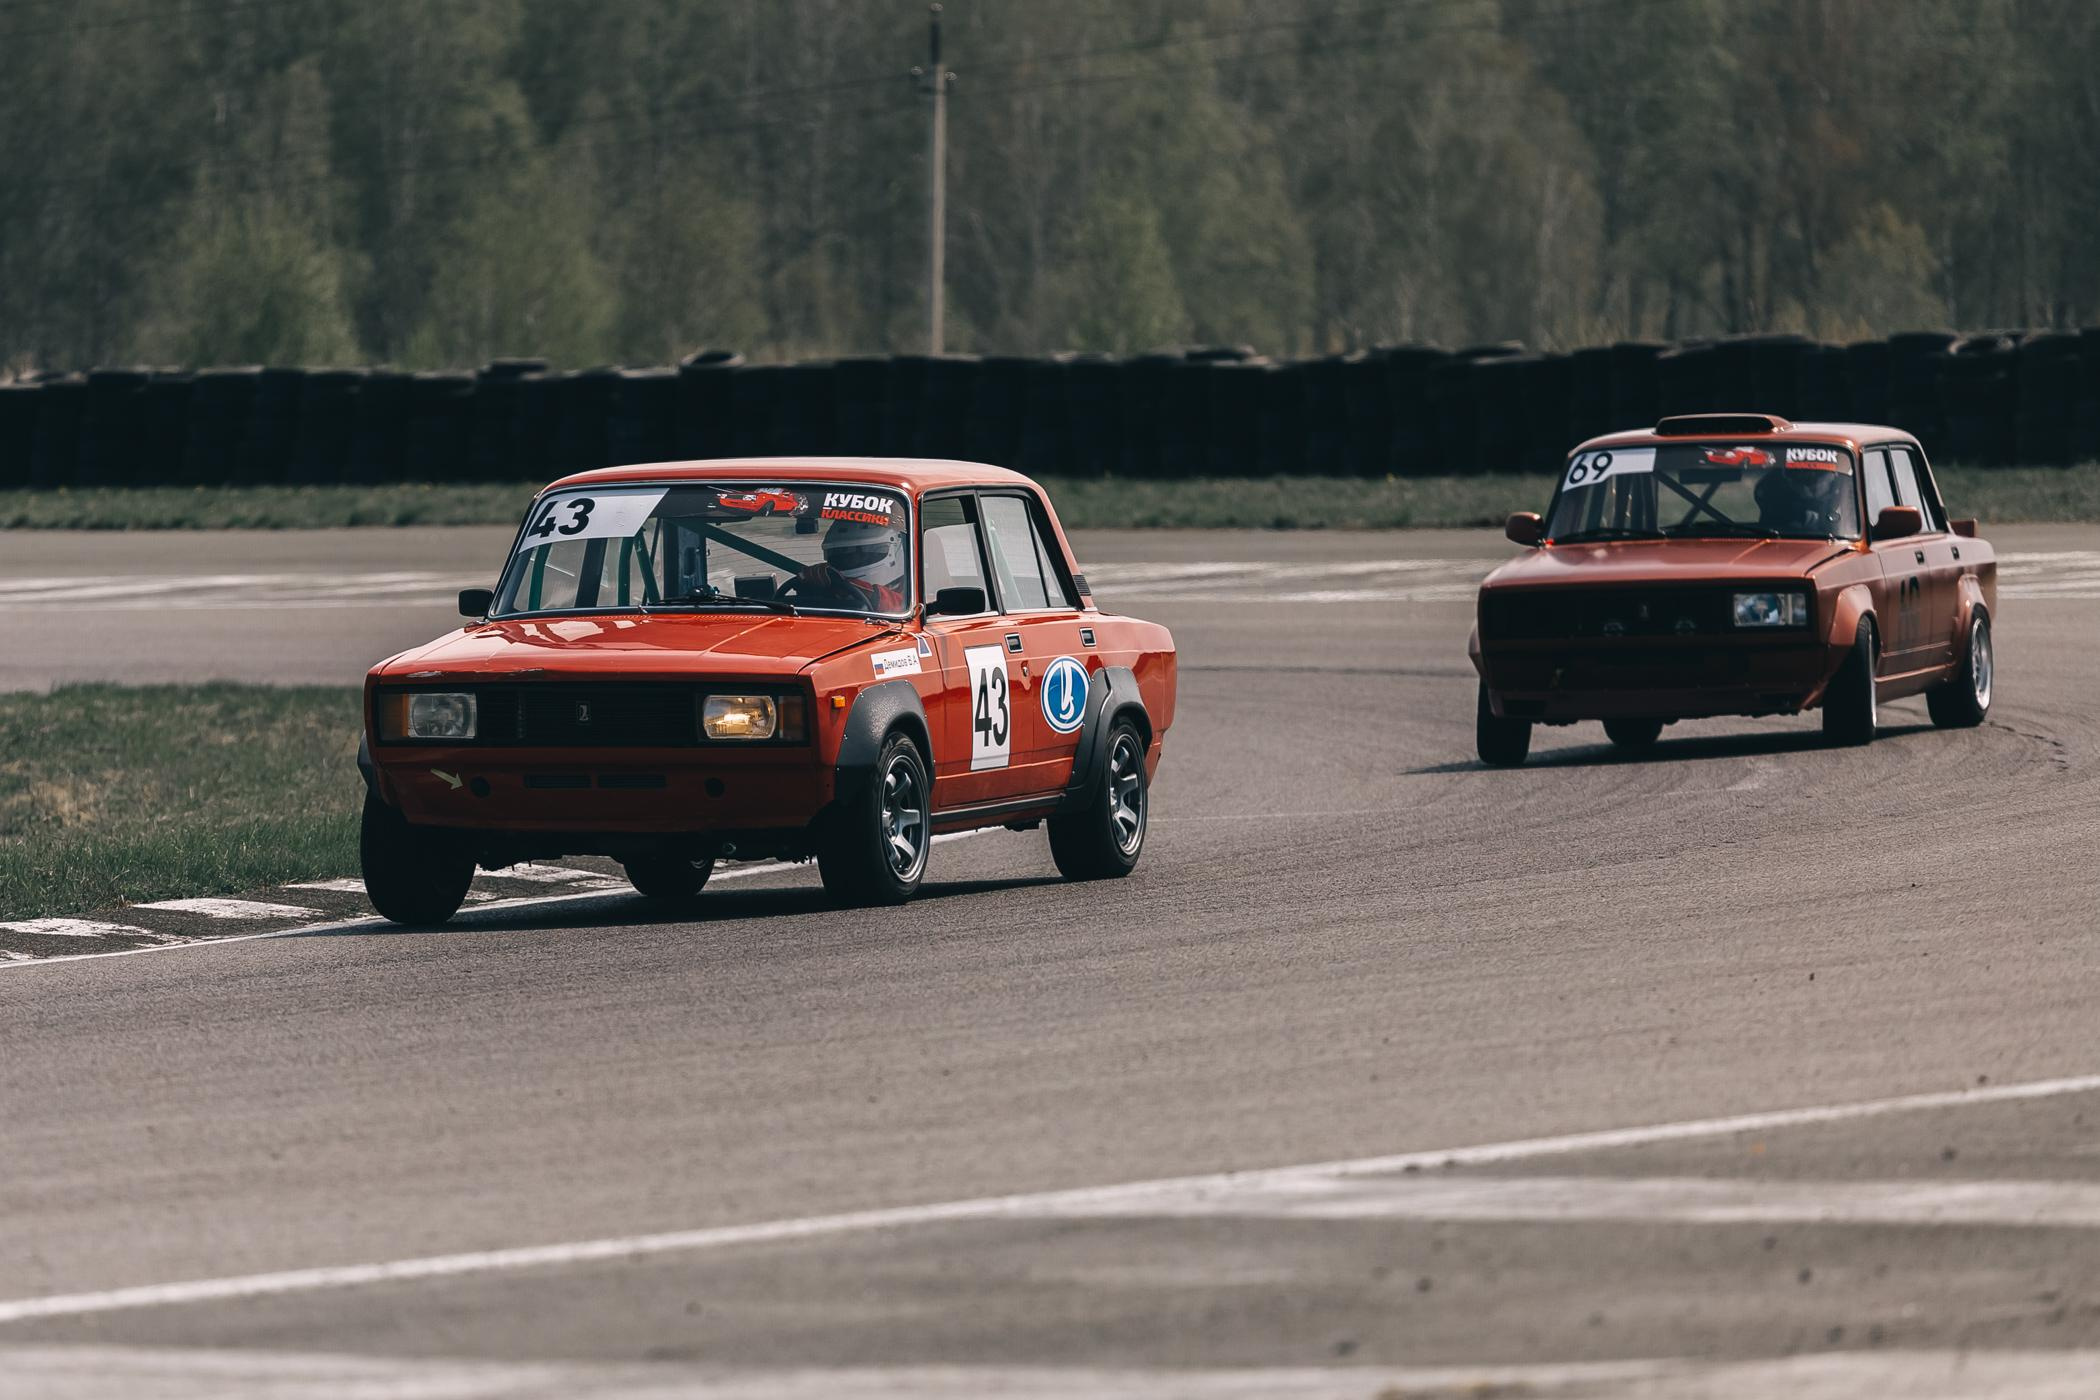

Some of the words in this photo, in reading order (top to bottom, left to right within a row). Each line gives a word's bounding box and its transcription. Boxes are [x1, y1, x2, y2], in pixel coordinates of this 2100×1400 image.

[1569, 452, 1612, 484] 69
[1786, 447, 1837, 462] КУБОК
[527, 498, 595, 538] 43
[823, 493, 894, 514] КУБОК
[974, 667, 1008, 747] 43
